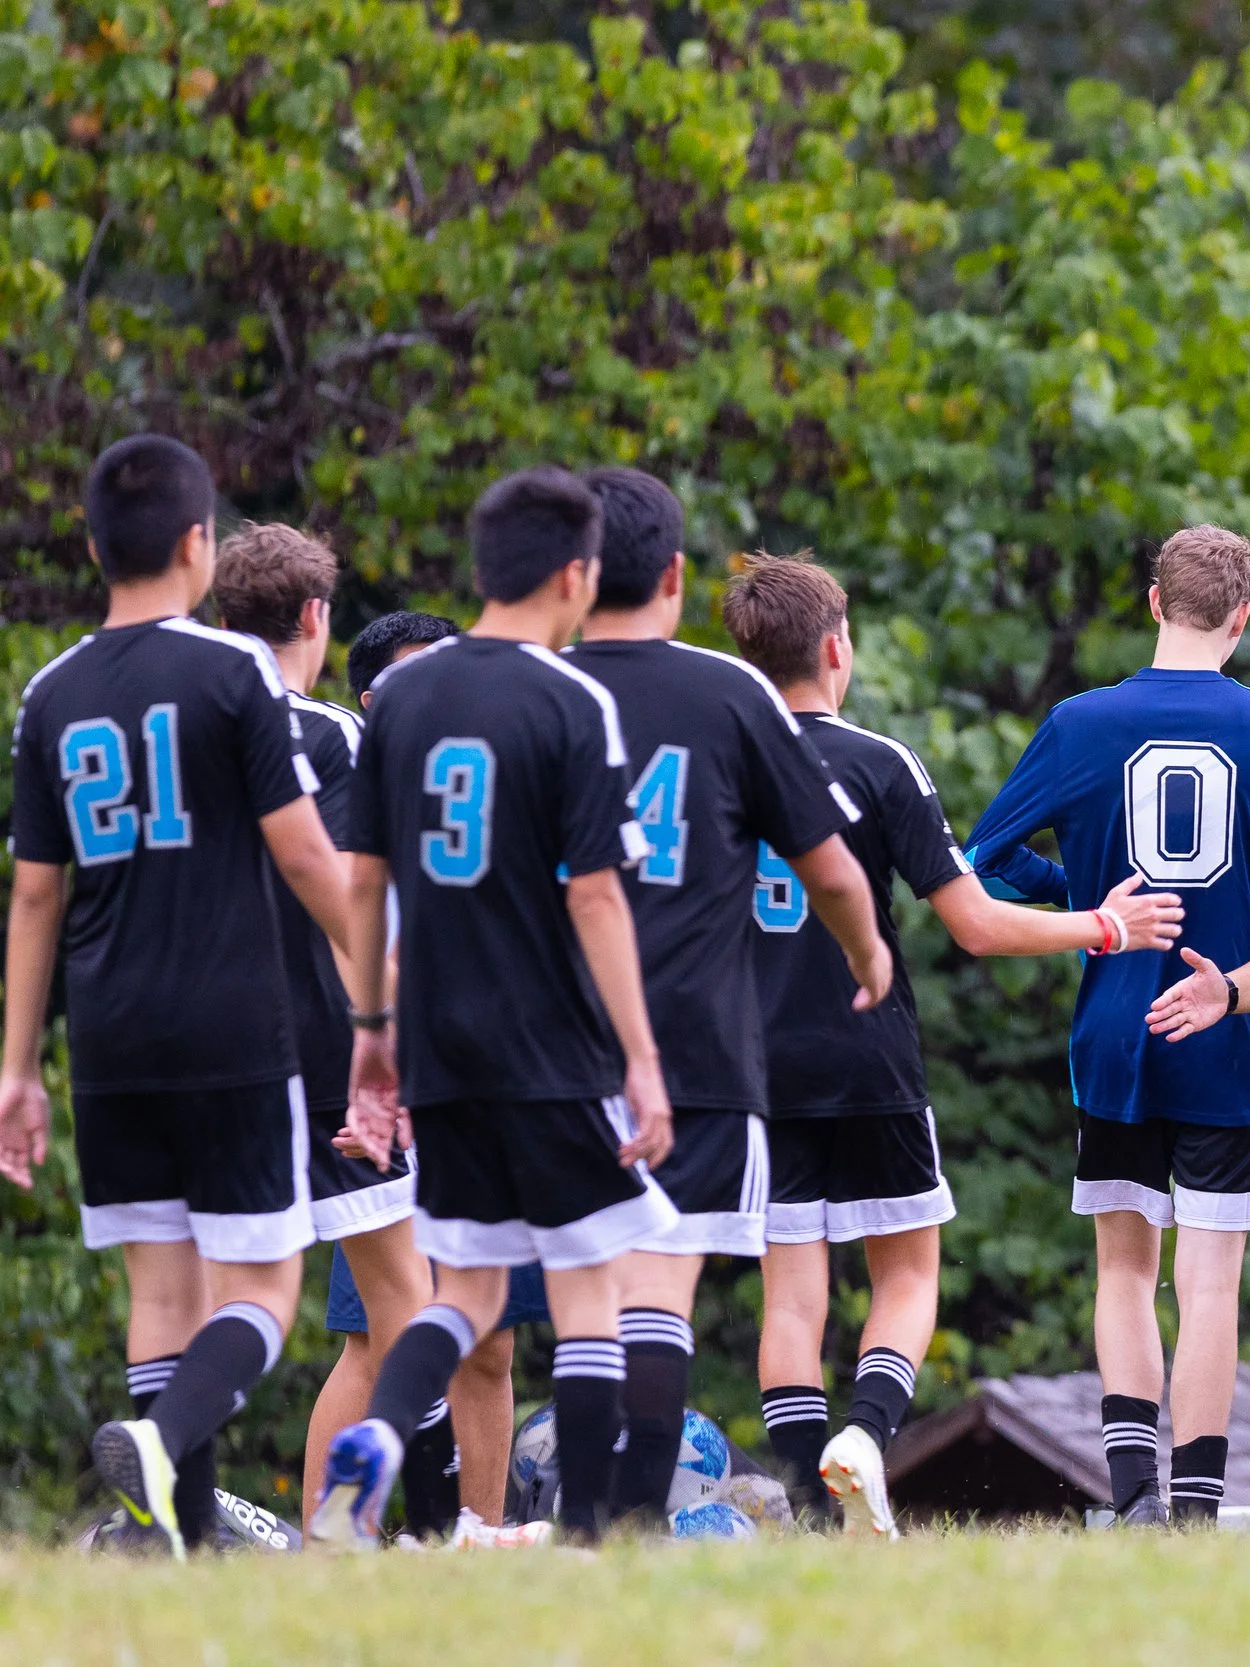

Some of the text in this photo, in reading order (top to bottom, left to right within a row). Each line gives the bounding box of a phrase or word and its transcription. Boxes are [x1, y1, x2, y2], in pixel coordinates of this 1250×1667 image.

[59, 702, 193, 867] 21
[420, 737, 496, 887] 3
[628, 743, 691, 887] 4
[1124, 740, 1237, 888] 0
[214, 1488, 289, 1549] didas
